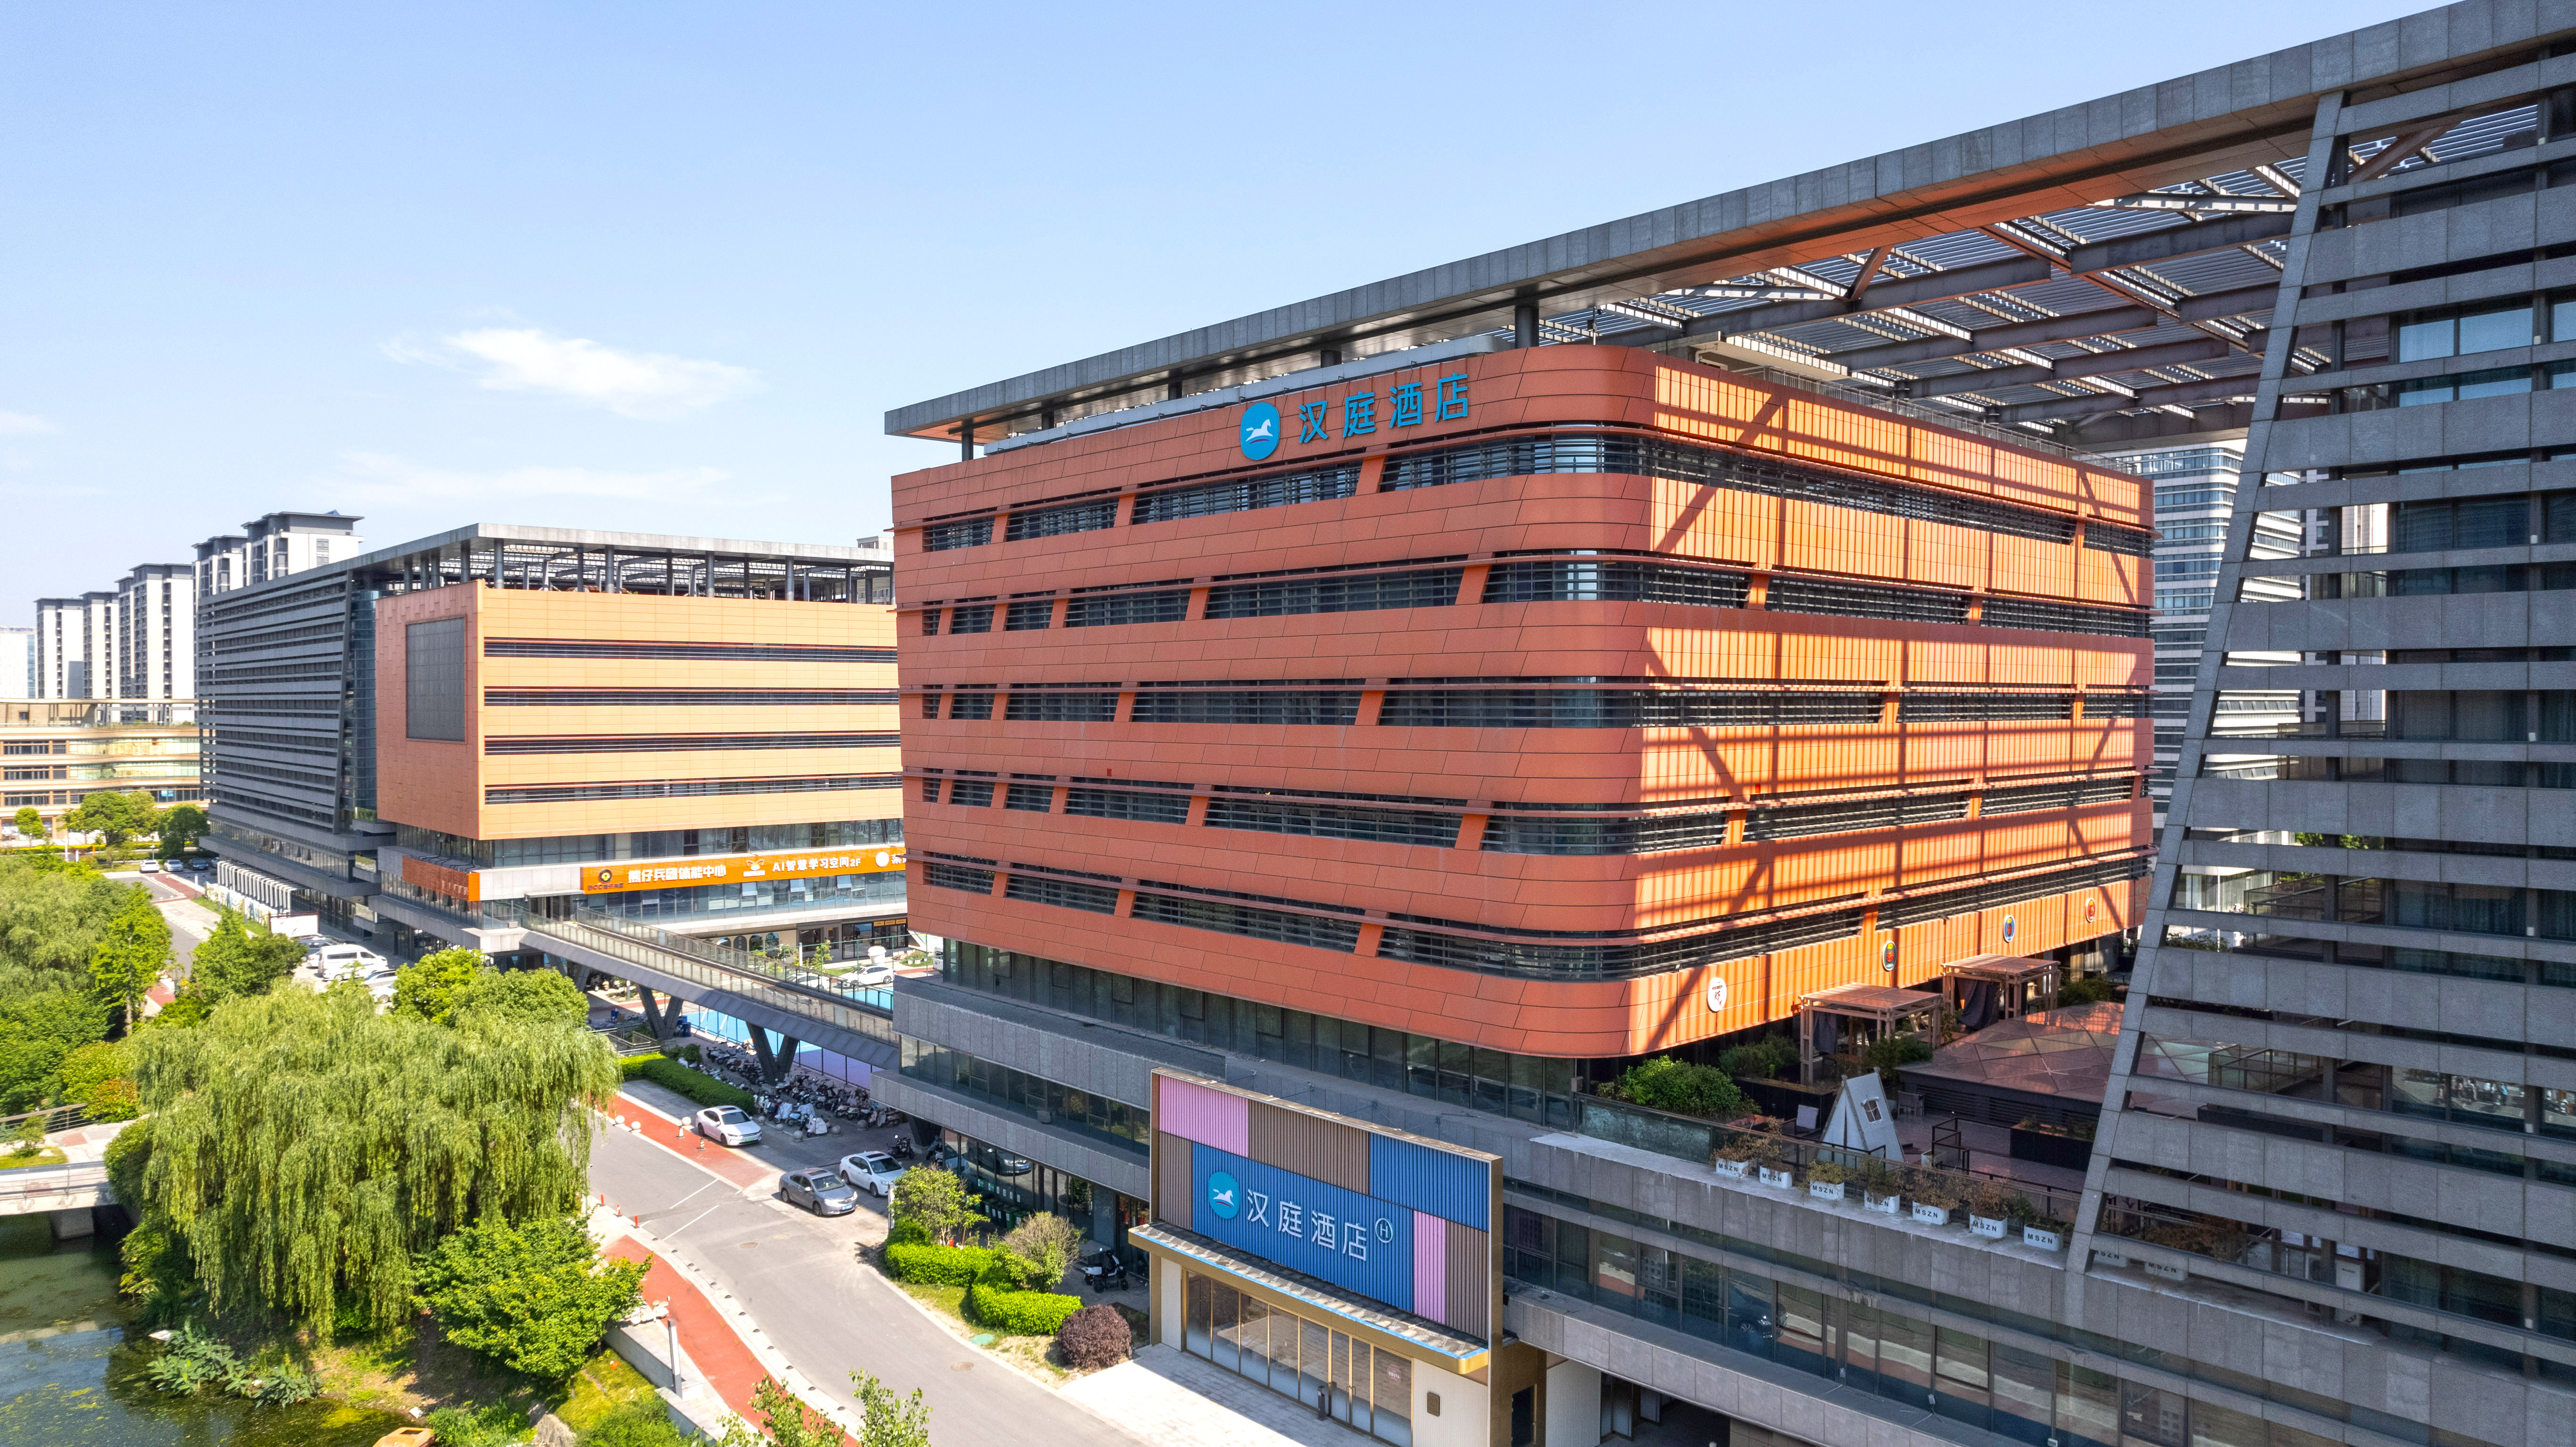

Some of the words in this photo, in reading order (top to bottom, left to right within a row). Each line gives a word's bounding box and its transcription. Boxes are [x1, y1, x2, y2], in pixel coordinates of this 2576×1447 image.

[1299, 372, 1468, 444] 汉庭酒店
[772, 856, 861, 872] AI智慧学习空间2F
[628, 864, 727, 883] 熊仔兵团体能中心
[1718, 1163, 1738, 1172] MSZN
[1762, 1173, 1782, 1182] MSZN
[1812, 1184, 1834, 1194] MSZN
[1867, 1197, 1889, 1207] MZN
[1915, 1208, 1938, 1218] MSZN
[1247, 1188, 1367, 1262] 汉庭酒店
[1973, 1221, 1997, 1232] MSZN
[2028, 1233, 2053, 1244] MSZN
